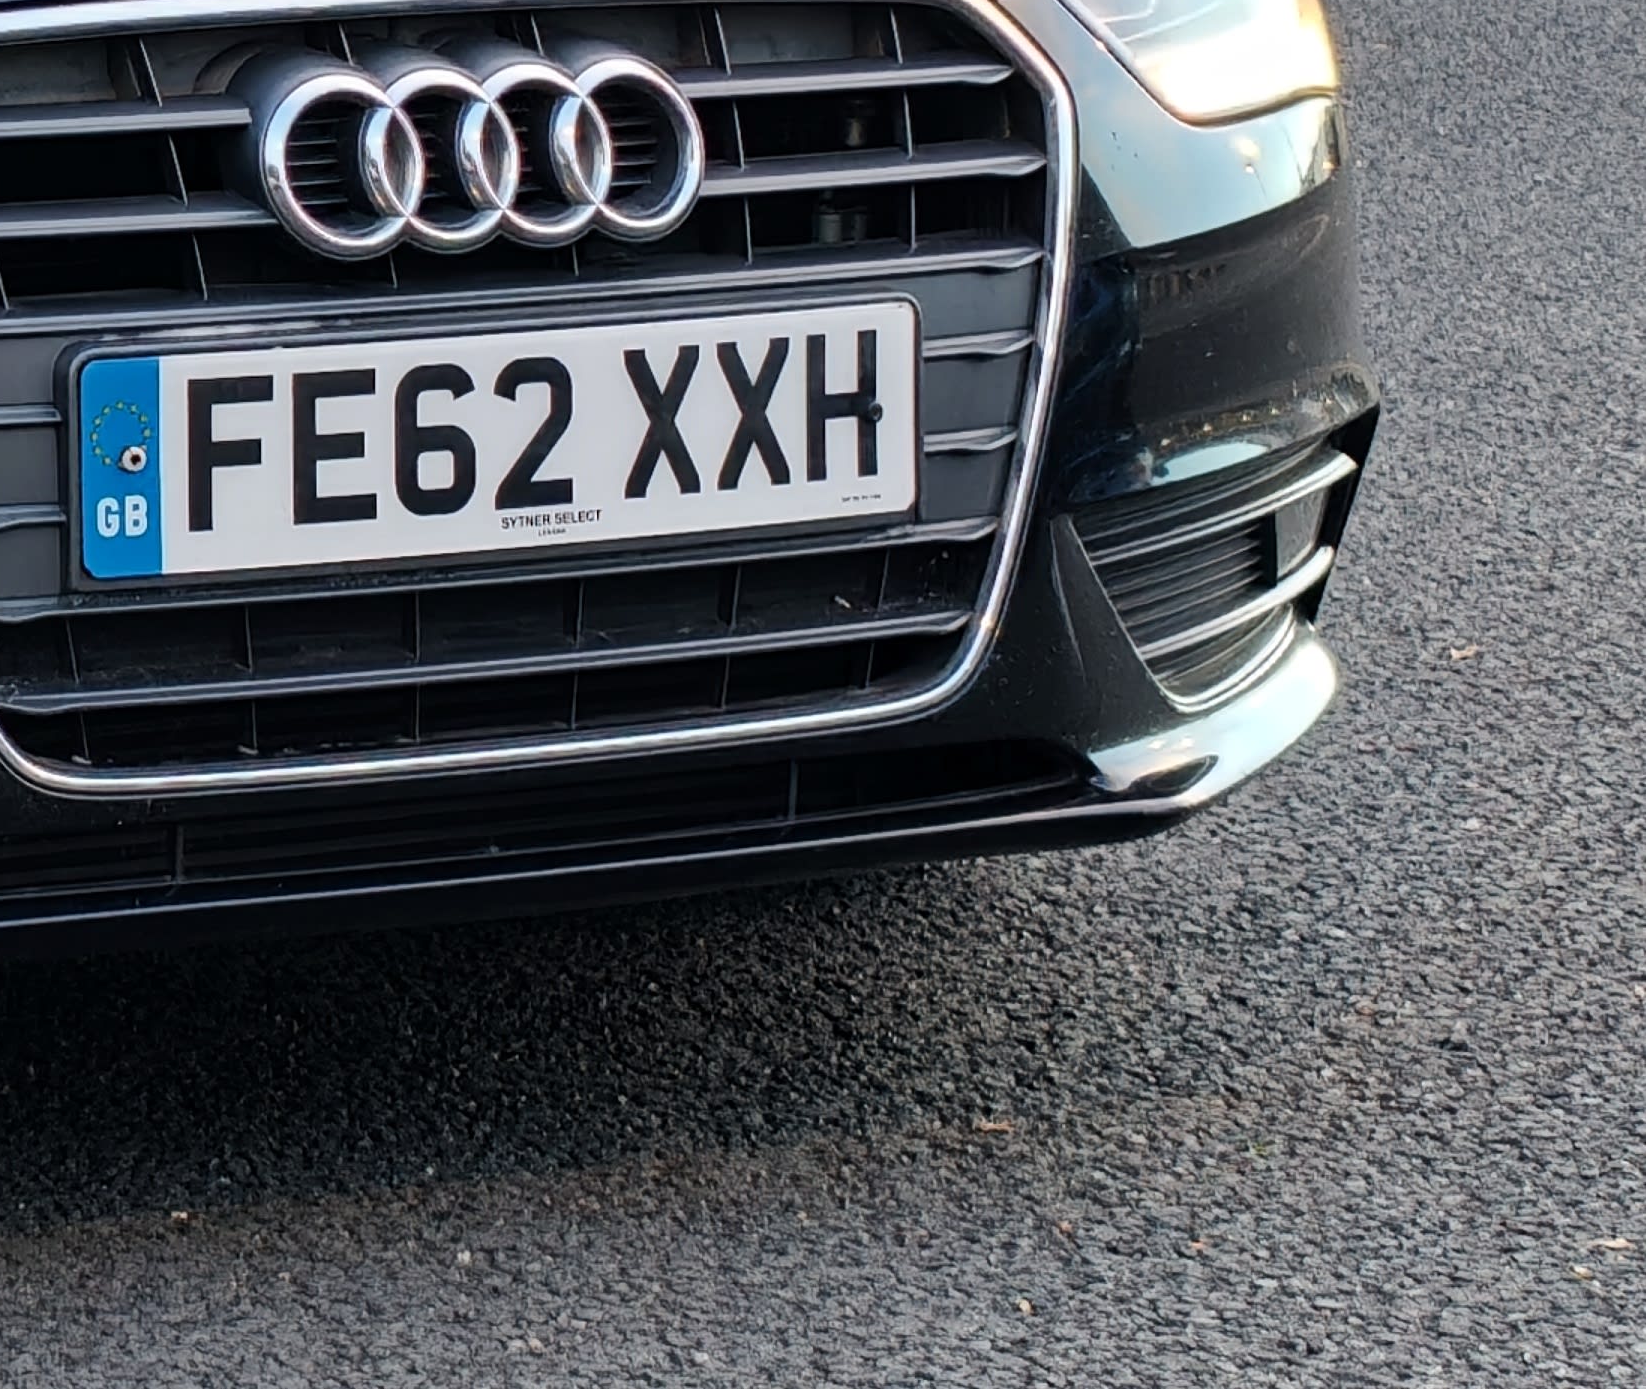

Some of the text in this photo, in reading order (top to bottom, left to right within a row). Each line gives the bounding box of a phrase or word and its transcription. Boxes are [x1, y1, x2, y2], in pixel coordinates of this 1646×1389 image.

[186, 328, 884, 533] FE62 XXH
[97, 495, 148, 538] GB
[500, 509, 602, 530] SYTNER SELECT
